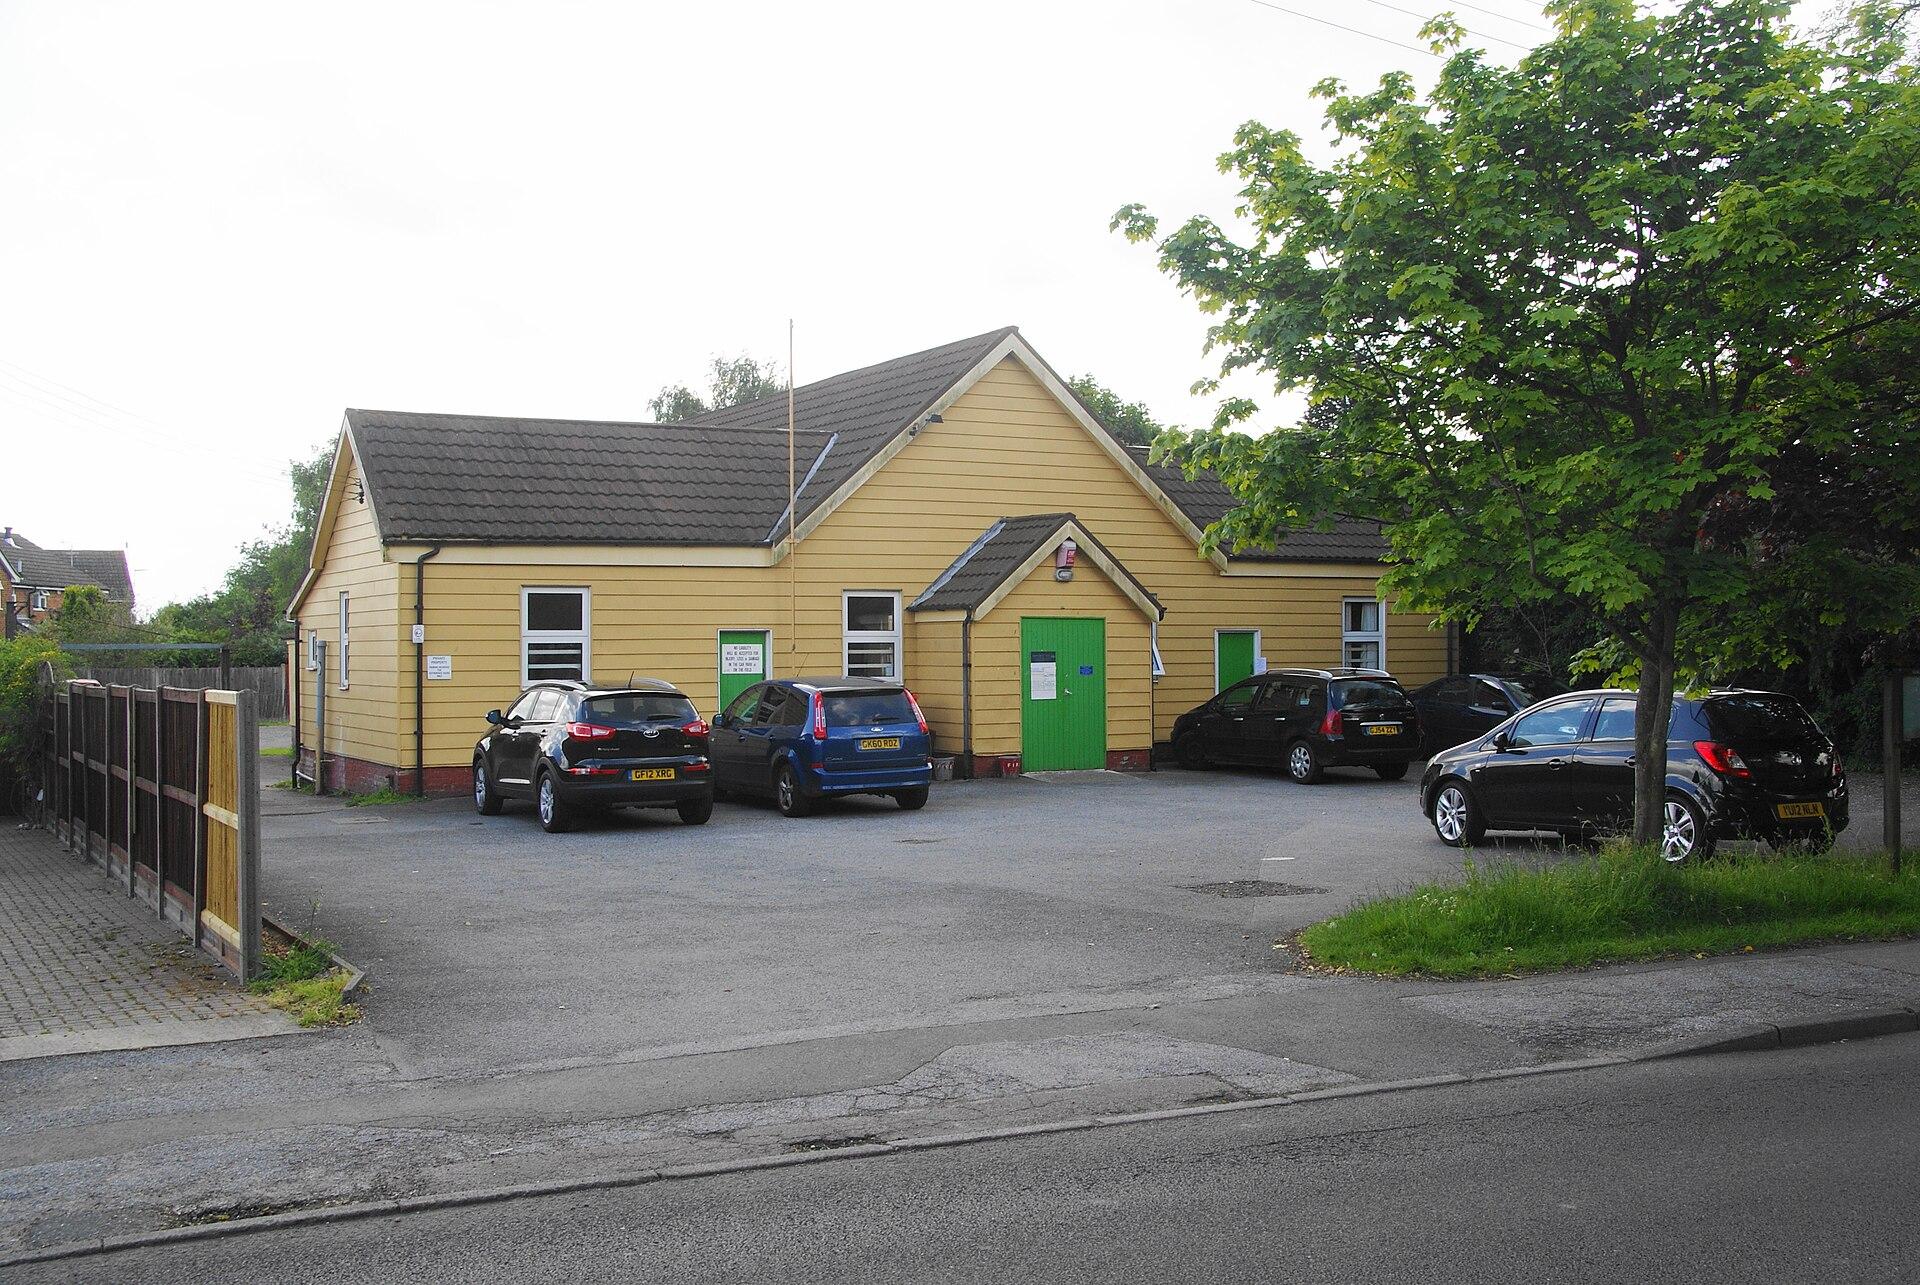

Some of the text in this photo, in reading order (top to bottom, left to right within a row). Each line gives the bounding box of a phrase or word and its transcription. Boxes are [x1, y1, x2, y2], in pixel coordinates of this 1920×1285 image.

[862, 739, 898, 749] GK60 RDZ
[634, 771, 653, 779] GF12
